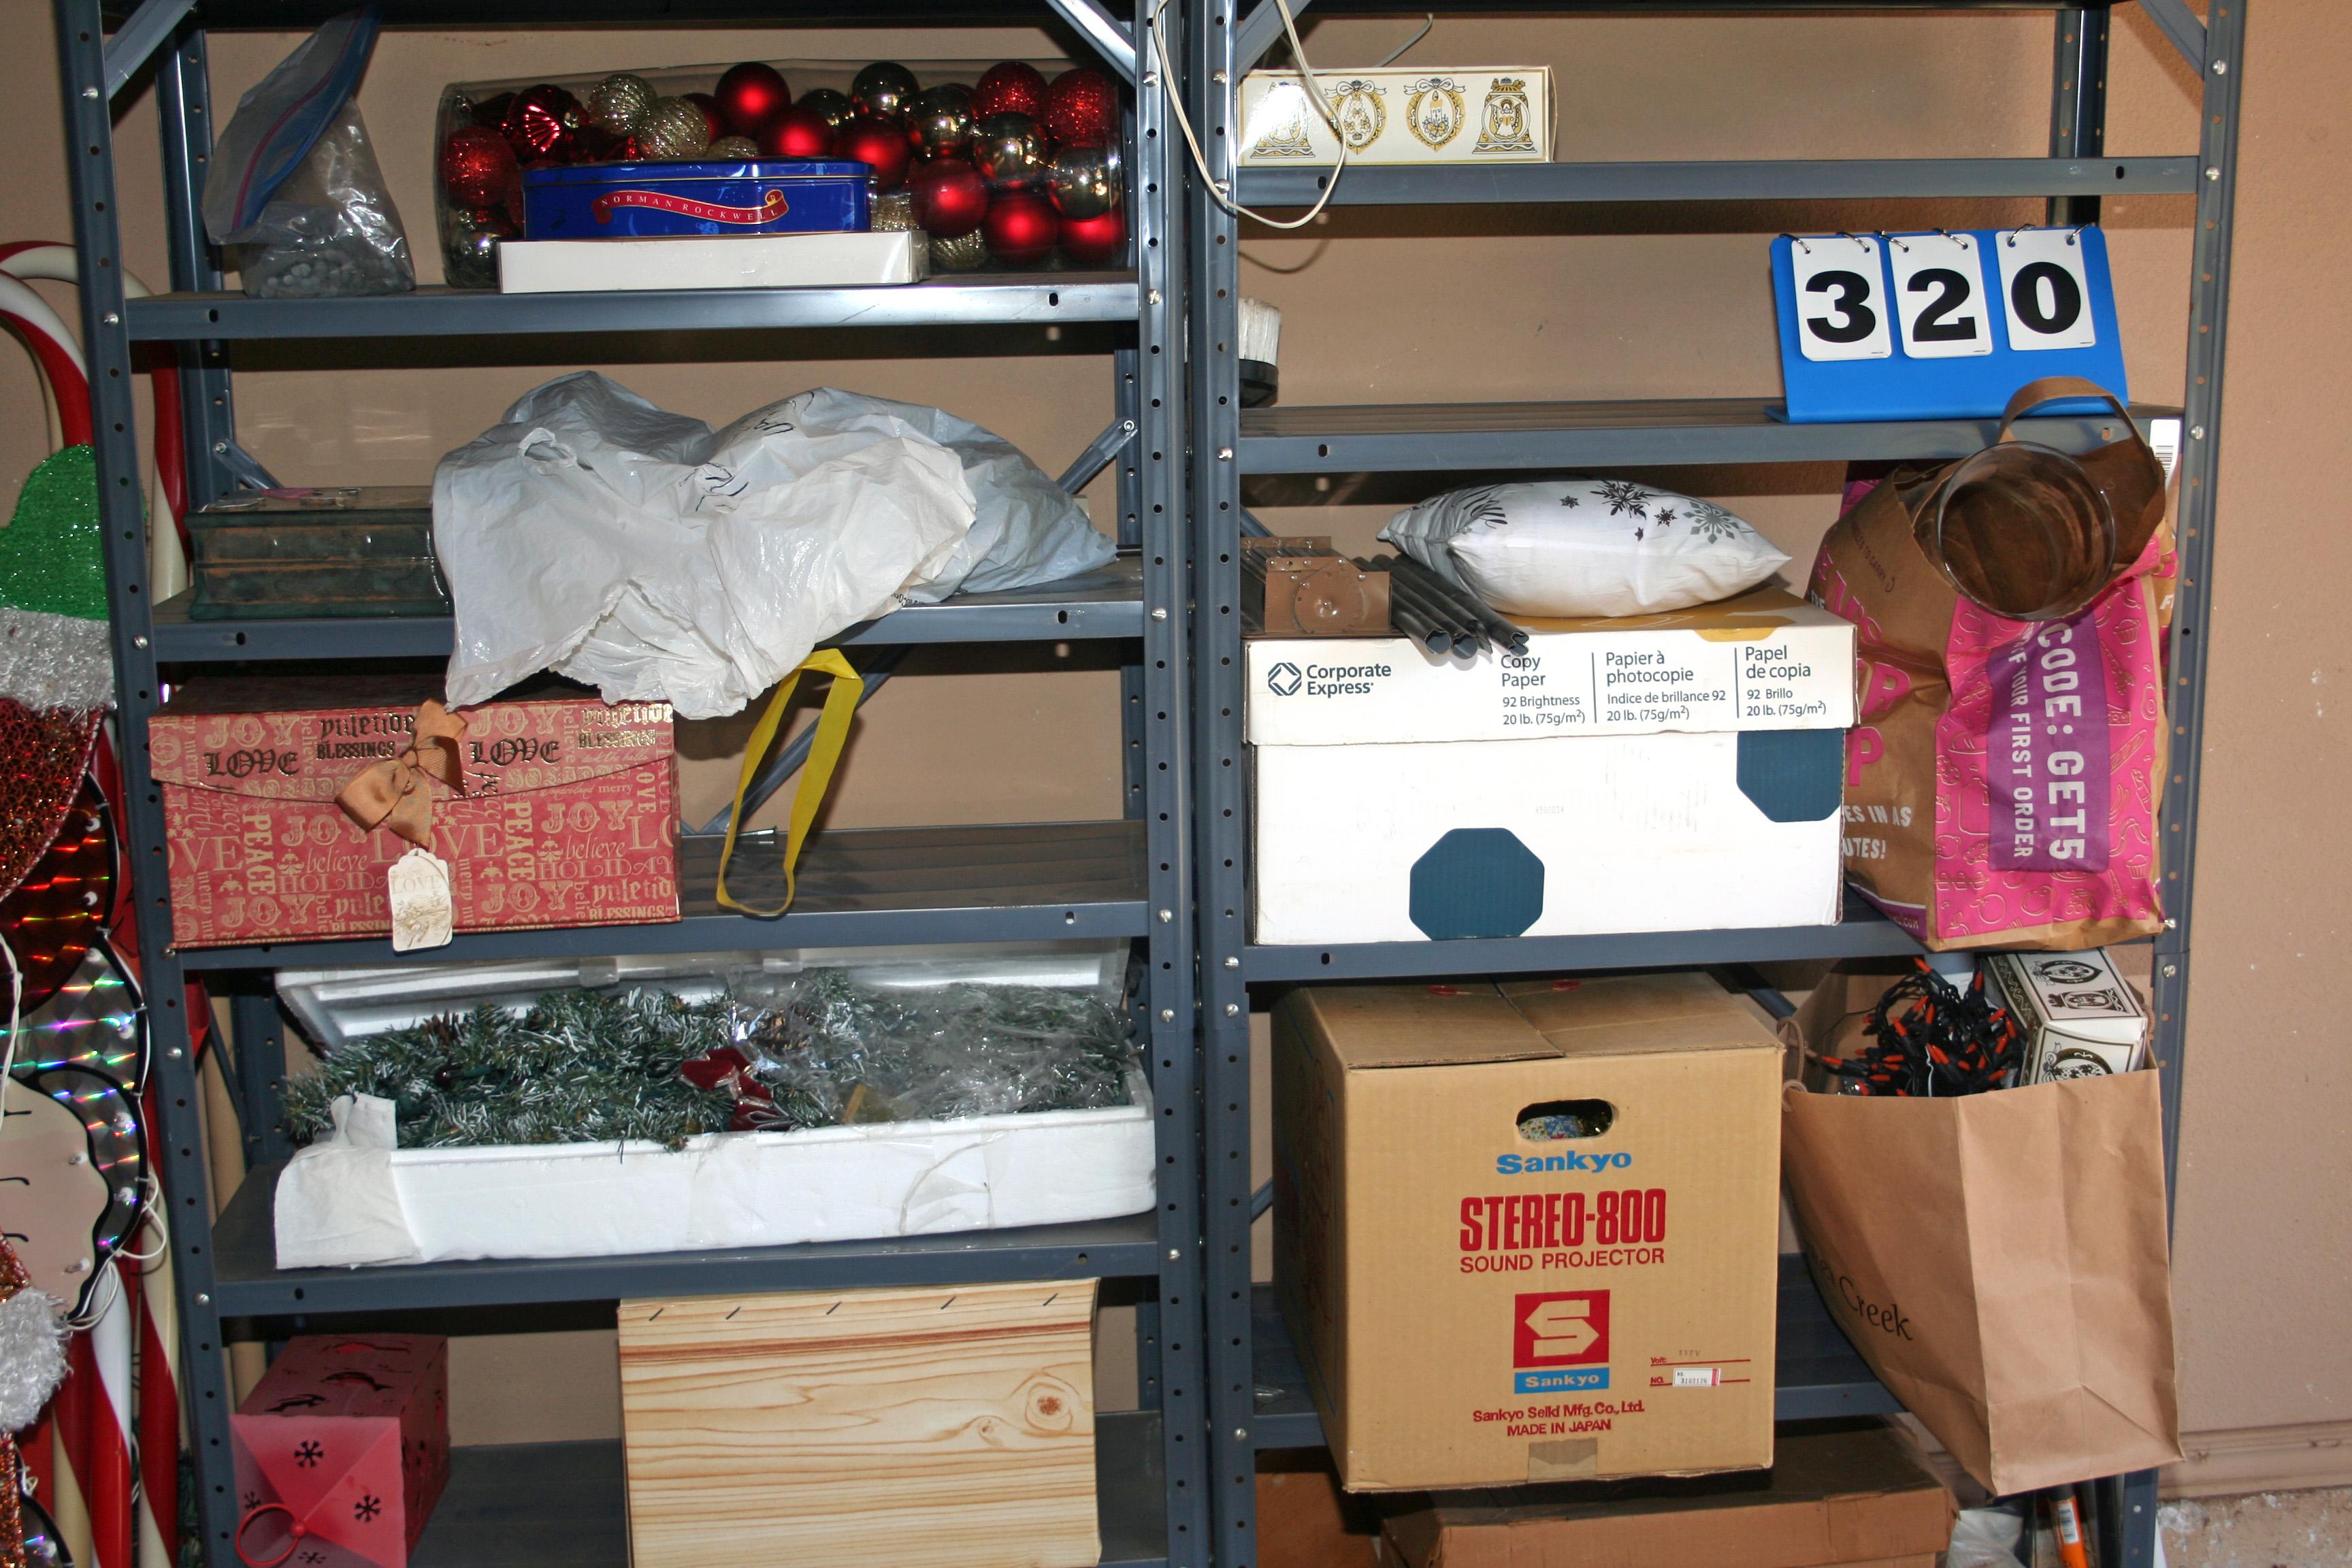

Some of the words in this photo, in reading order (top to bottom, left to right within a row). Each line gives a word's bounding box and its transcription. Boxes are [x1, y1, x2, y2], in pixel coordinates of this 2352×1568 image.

[602, 195, 674, 208] NORMAN
[682, 203, 778, 220] ROCKWELL
[1501, 654, 1541, 672] Copy
[1606, 651, 1653, 669] Papier
[1656, 650, 1665, 664] à
[1746, 644, 1787, 664] Papel
[1306, 663, 1392, 681] Corporate
[1502, 672, 1546, 690] Paper
[1607, 667, 1694, 687] photocopie
[1746, 664, 1766, 679] de
[1769, 663, 1811, 681] copia
[2037, 622, 2082, 736] CODE:
[1307, 681, 1373, 698] Express
[1607, 693, 1642, 704] Indice
[1644, 691, 1659, 704] de
[1662, 690, 1710, 704] brillance
[1712, 690, 1726, 701] 92
[1747, 689, 1761, 700] 92
[1765, 687, 1793, 700] Brillo
[2010, 665, 2029, 707] YOUR
[1503, 696, 1517, 708] 92
[1520, 695, 1580, 709] Brightness
[1746, 705, 1761, 716] 20
[1763, 704, 1776, 716] lb.
[469, 703, 563, 737] JOY
[1503, 715, 1517, 725] 20
[1520, 713, 1533, 725] lb.
[1607, 710, 1621, 721] 20
[1624, 709, 1637, 721] lb.
[205, 715, 300, 748] JOY
[562, 704, 579, 763] believe
[301, 715, 318, 774] believe
[316, 740, 395, 760] BLESSINGS
[468, 737, 561, 767] LOVE
[2010, 712, 2033, 779] FIRST
[203, 749, 300, 778] LOVE
[598, 784, 634, 795] merry
[541, 800, 634, 834] JOY
[1867, 805, 1889, 823] IN
[1892, 806, 1912, 828] AS
[2046, 750, 2086, 860] GET5
[2012, 786, 2035, 858] ORDER
[504, 800, 536, 882] PEACE
[566, 832, 627, 860] believe
[242, 813, 277, 896] PEACE
[306, 847, 368, 874] believe
[481, 879, 574, 914] JOY
[220, 894, 315, 928] JOY
[1496, 1150, 1632, 1175] Sankyo
[1460, 1188, 1667, 1252] STEREO-800
[1460, 1254, 1534, 1273] SOUND
[1541, 1247, 1665, 1269] PROJECTOR
[1840, 1276, 1913, 1341] Creek
[1525, 1373, 1601, 1388] Sankyo
[1473, 1408, 1524, 1422] Sankyo
[1565, 1403, 1593, 1418] Mfg.
[1621, 1399, 1646, 1414] Ltd.
[1507, 1423, 1547, 1437] MADE
[1551, 1422, 1565, 1434] IN
[1568, 1419, 1612, 1433] JAPAN
